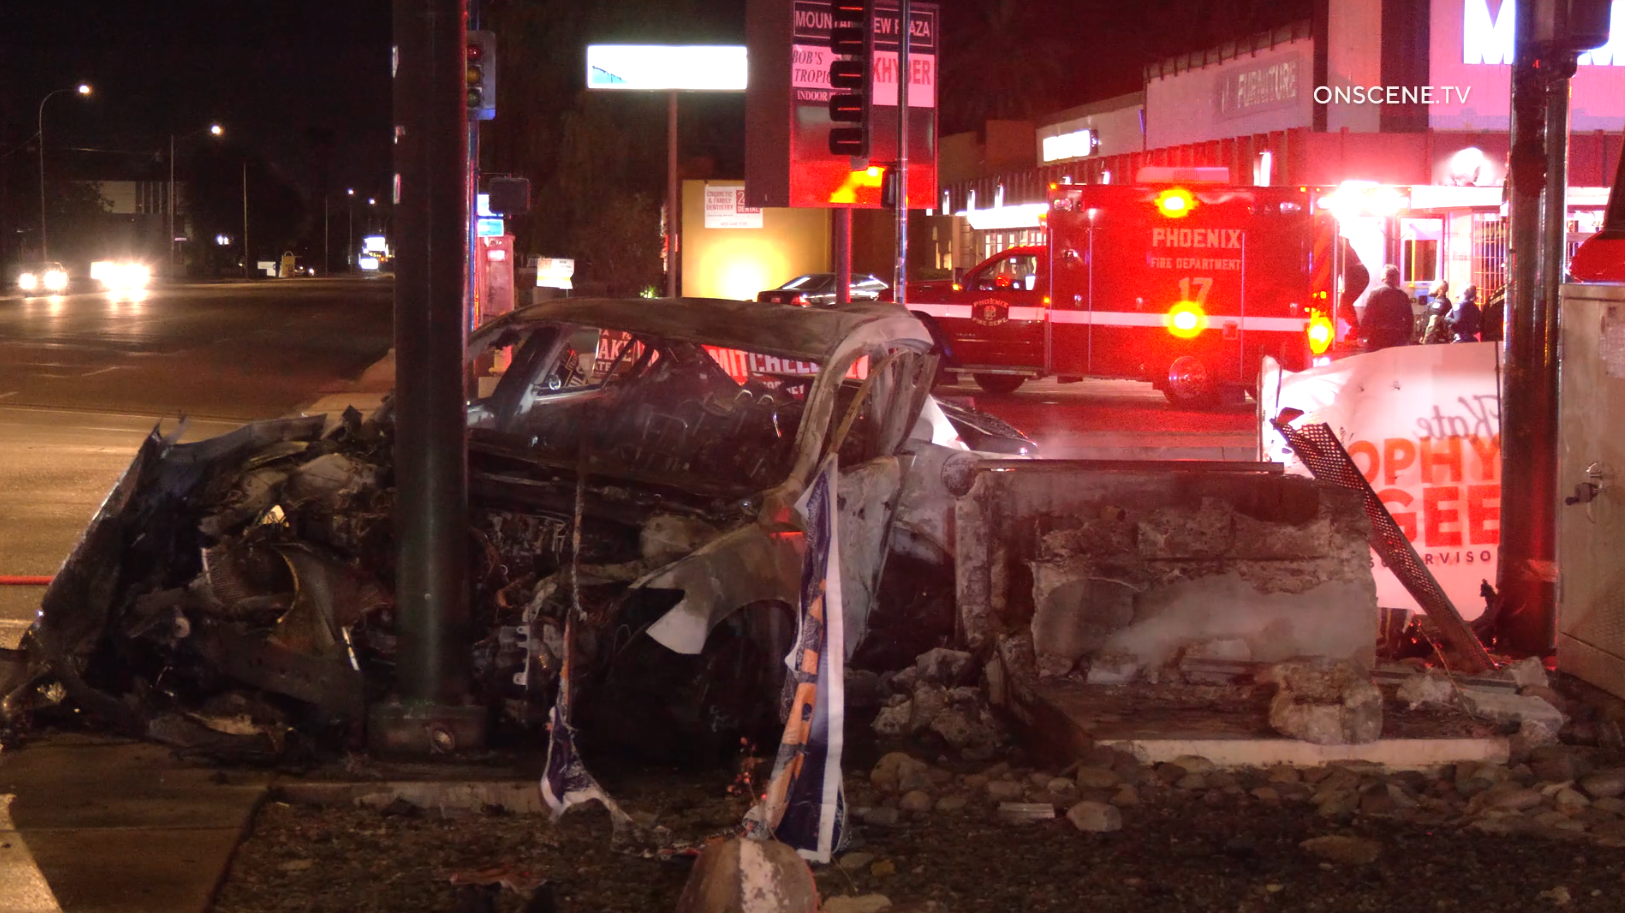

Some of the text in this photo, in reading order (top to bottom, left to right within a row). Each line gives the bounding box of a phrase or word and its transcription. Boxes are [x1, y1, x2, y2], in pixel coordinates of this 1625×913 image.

[895, 19, 930, 37] PAZA
[792, 50, 823, 65] BOB'S
[873, 57, 931, 85] KHYER
[797, 90, 828, 102] INDOOR
[1152, 227, 1241, 249] PHOENIX
[1151, 257, 1241, 271] FIRE DEPARTMENT
[1178, 276, 1213, 307] 17
[973, 298, 1010, 309] PHOENIX
[1347, 433, 1500, 487] OPHY
[1376, 485, 1501, 548] GEE
